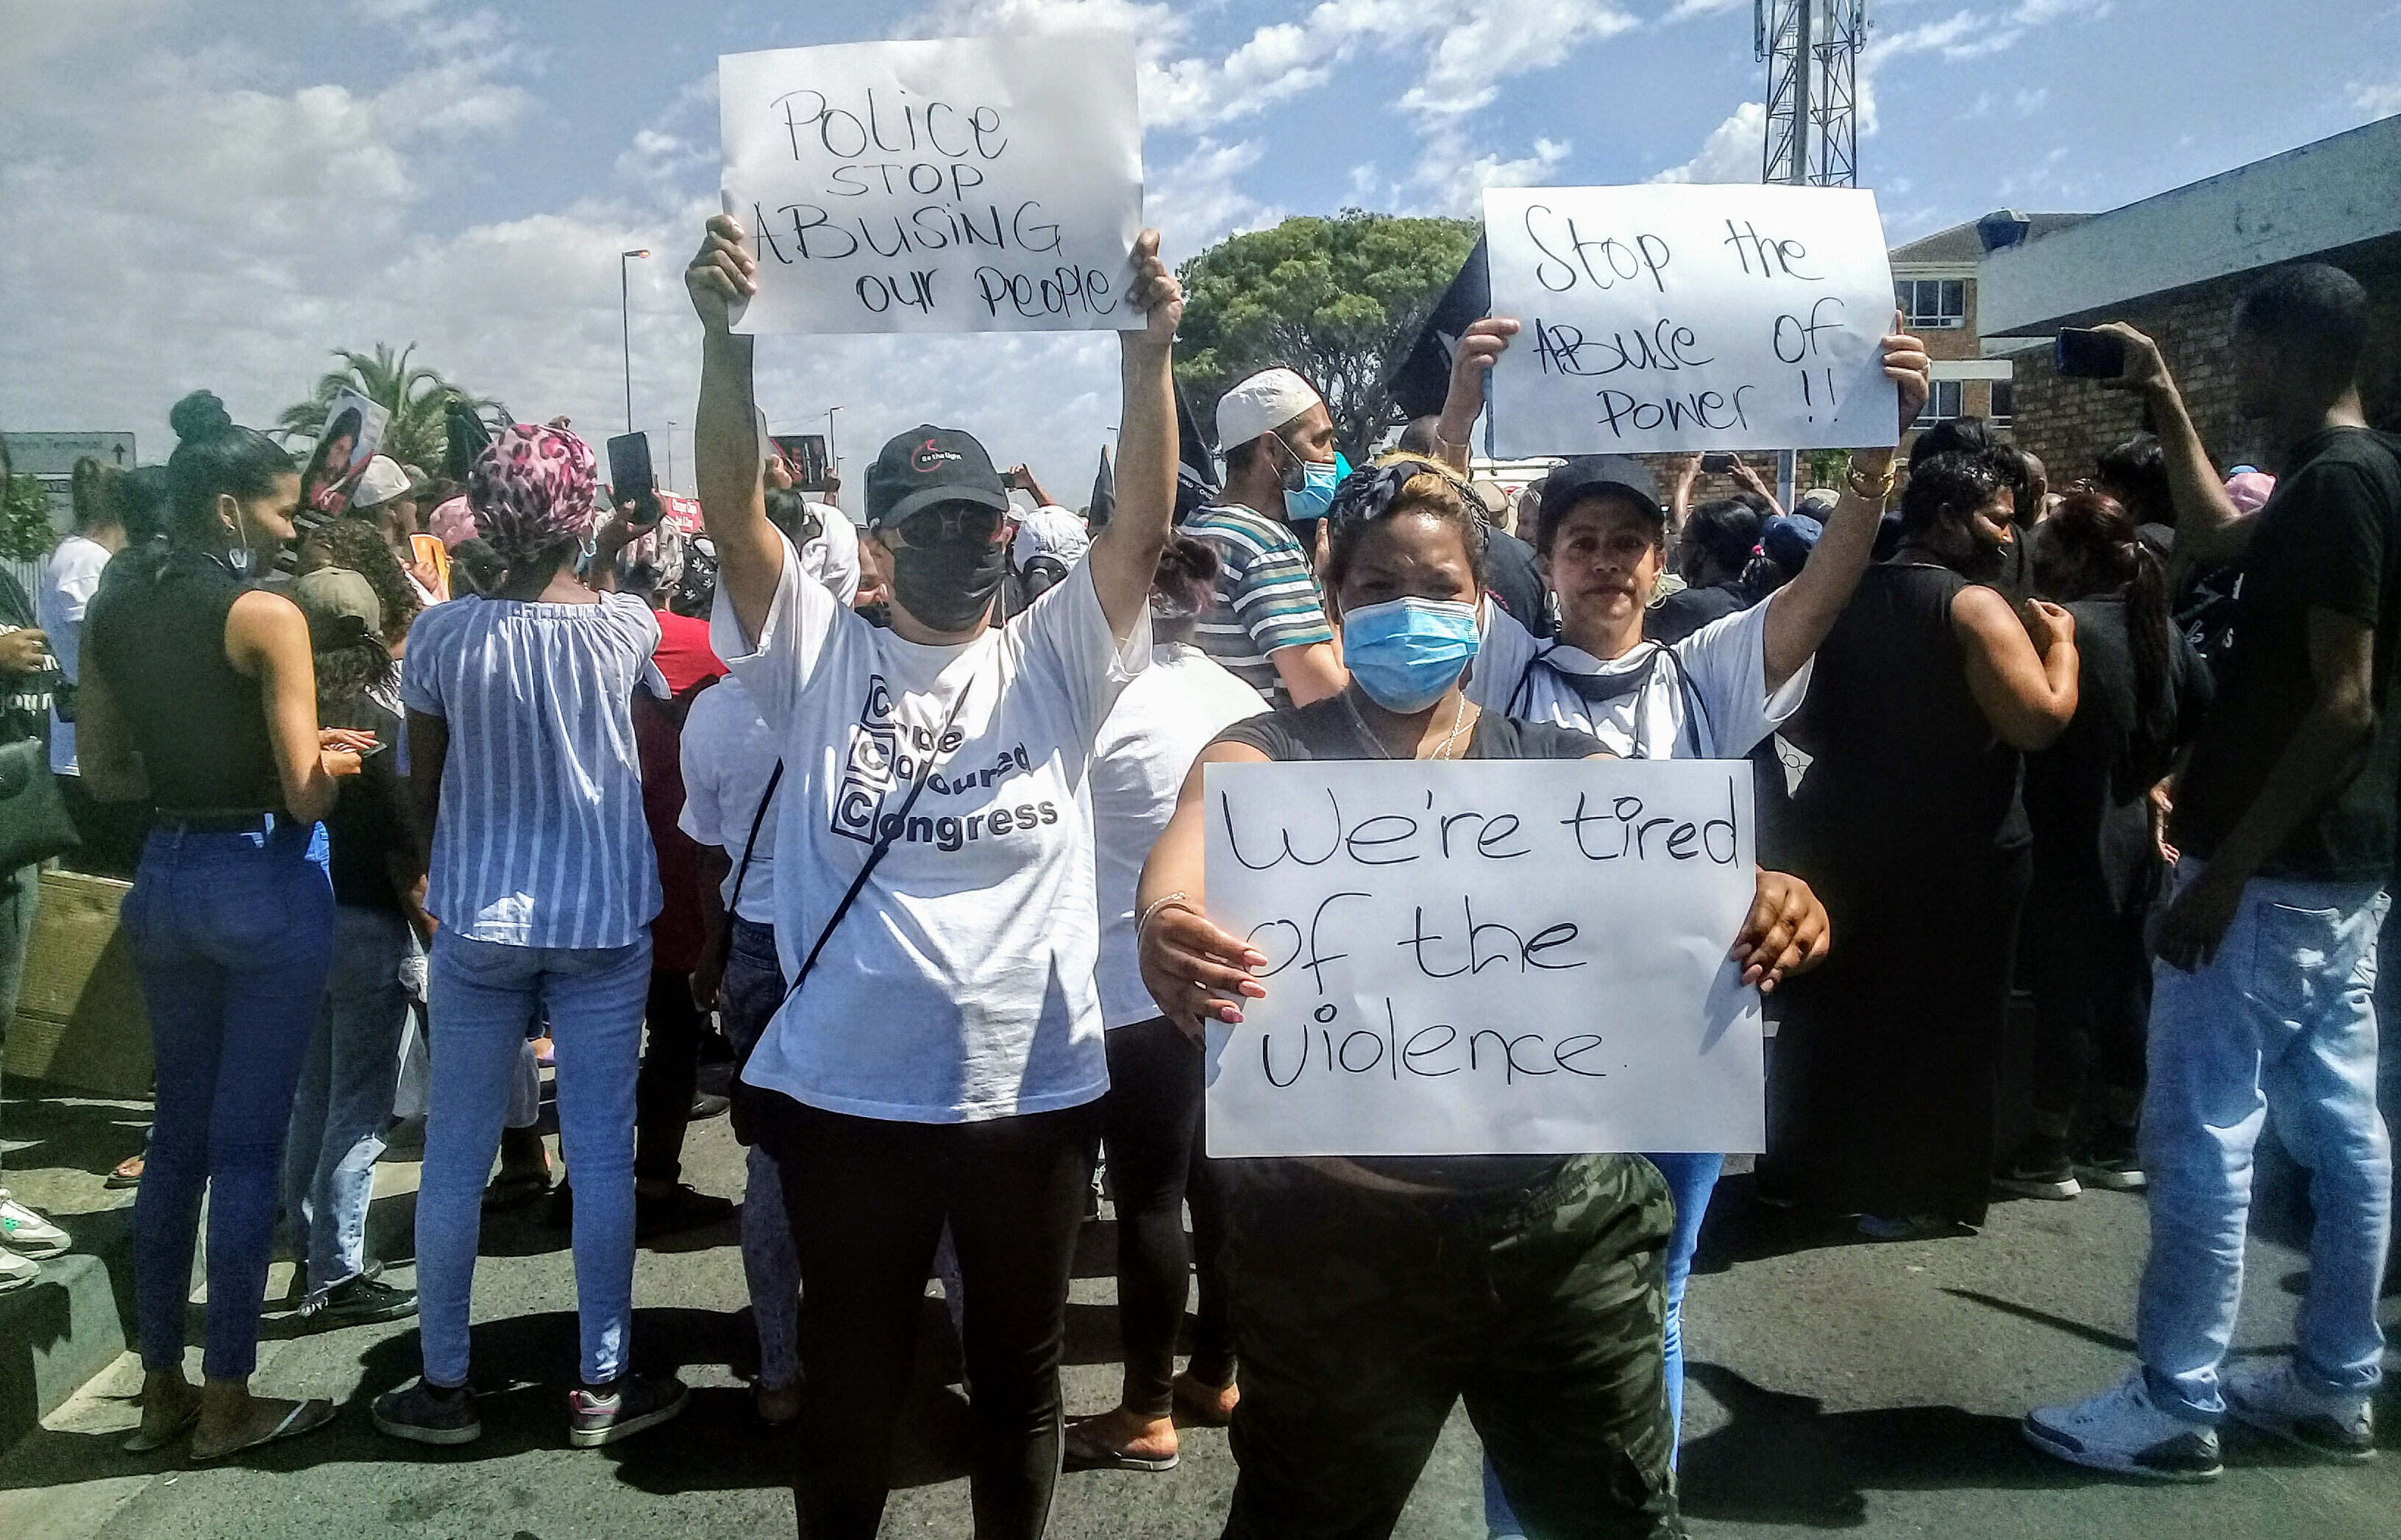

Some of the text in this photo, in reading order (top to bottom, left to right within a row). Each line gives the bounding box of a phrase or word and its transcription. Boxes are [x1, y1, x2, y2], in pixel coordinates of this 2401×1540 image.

[826, 163, 984, 202] STOP
[1525, 204, 1825, 293] Stop the
[856, 268, 939, 315] our
[872, 684, 963, 754] Cpe
[858, 740, 1033, 796] Cooured
[1220, 774, 1740, 870] We're tired
[1397, 894, 1587, 980] the
